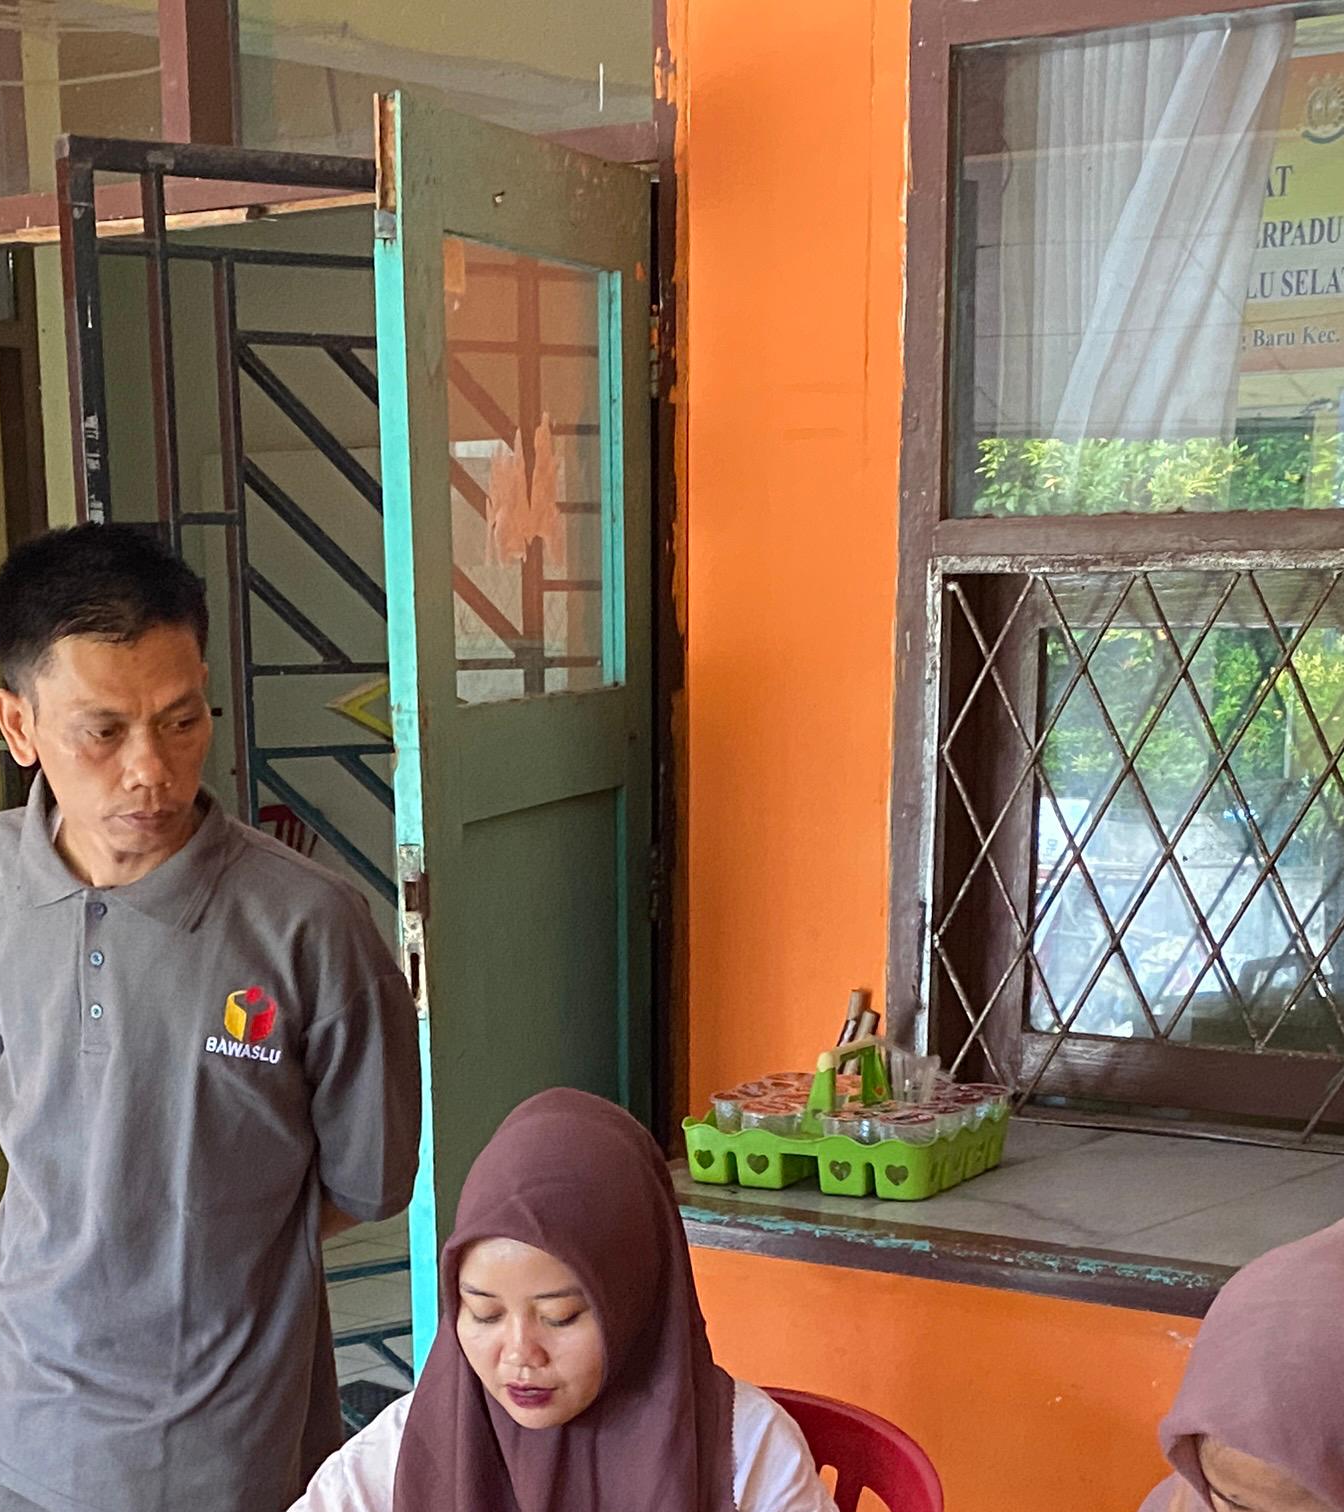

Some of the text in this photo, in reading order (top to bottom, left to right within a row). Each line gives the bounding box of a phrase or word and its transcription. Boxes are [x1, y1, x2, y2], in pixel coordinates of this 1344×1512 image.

[1256, 216, 1342, 249] RPADU
[1254, 328, 1295, 347] Baru
[1303, 324, 1340, 345] Kec.
[205, 1035, 282, 1065] BAWASLU
